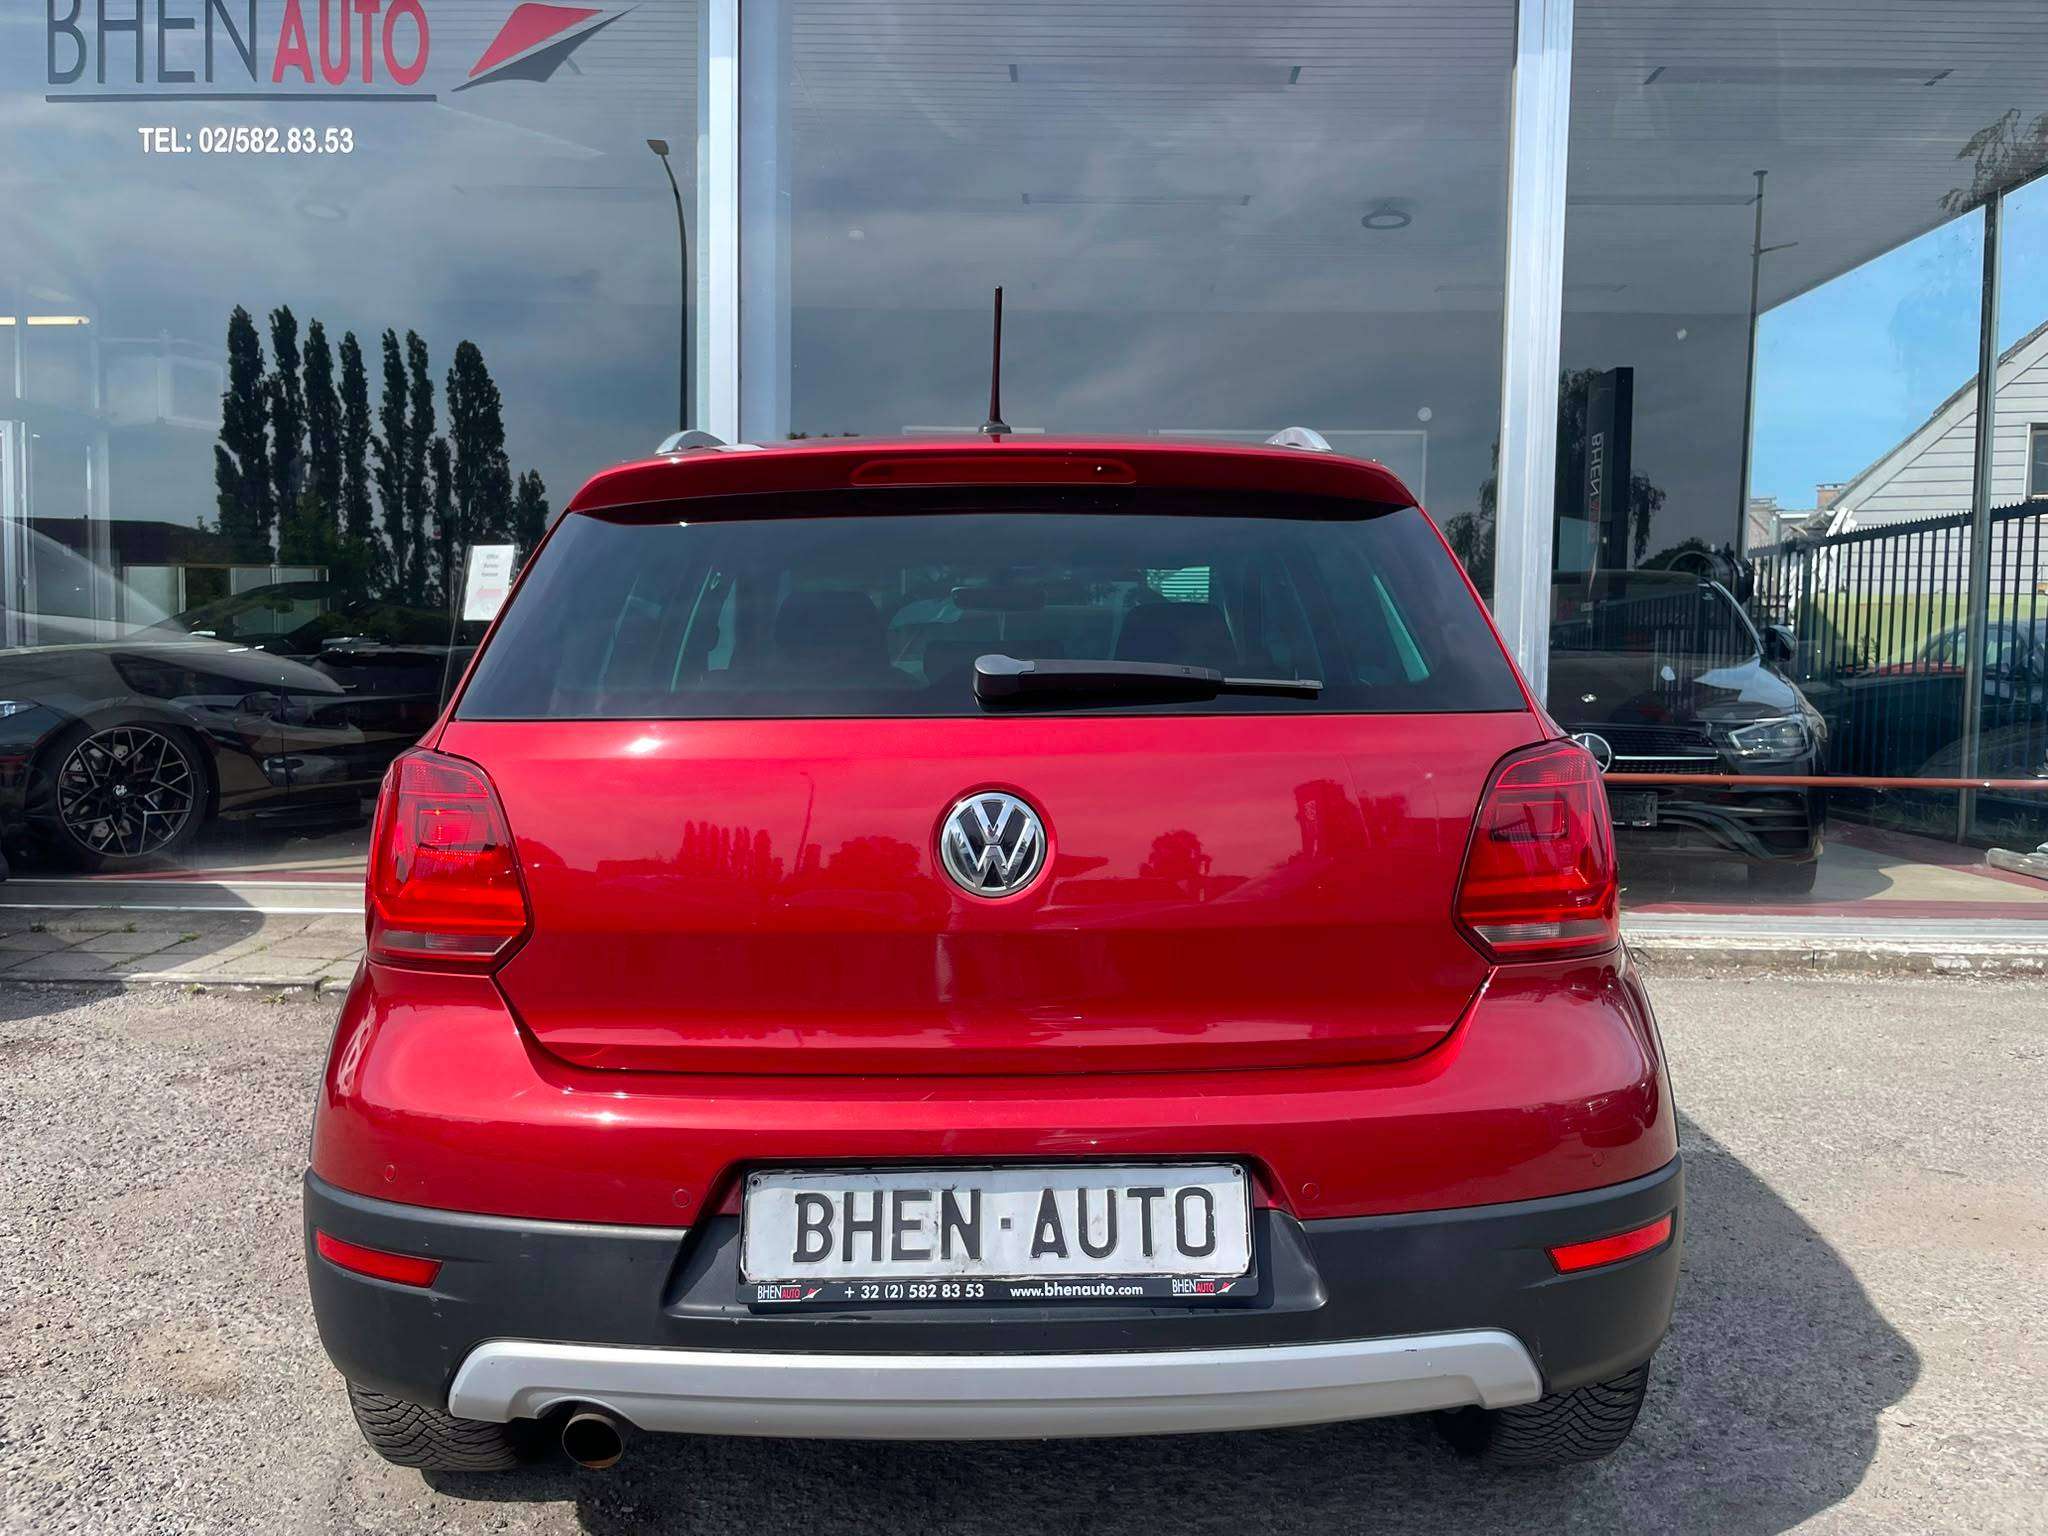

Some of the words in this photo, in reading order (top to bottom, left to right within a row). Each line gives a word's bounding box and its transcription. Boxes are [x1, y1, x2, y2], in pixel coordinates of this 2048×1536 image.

[138, 127, 192, 154] TEL:
[199, 127, 354, 154] 02/582.83.53
[861, 1285, 879, 1299] 32
[885, 1284, 904, 1299] (2)
[909, 1284, 937, 1298] 582
[942, 1284, 961, 1298] 83
[966, 1283, 984, 1298] 53
[1010, 1282, 1144, 1297] www.bhenauto.com
